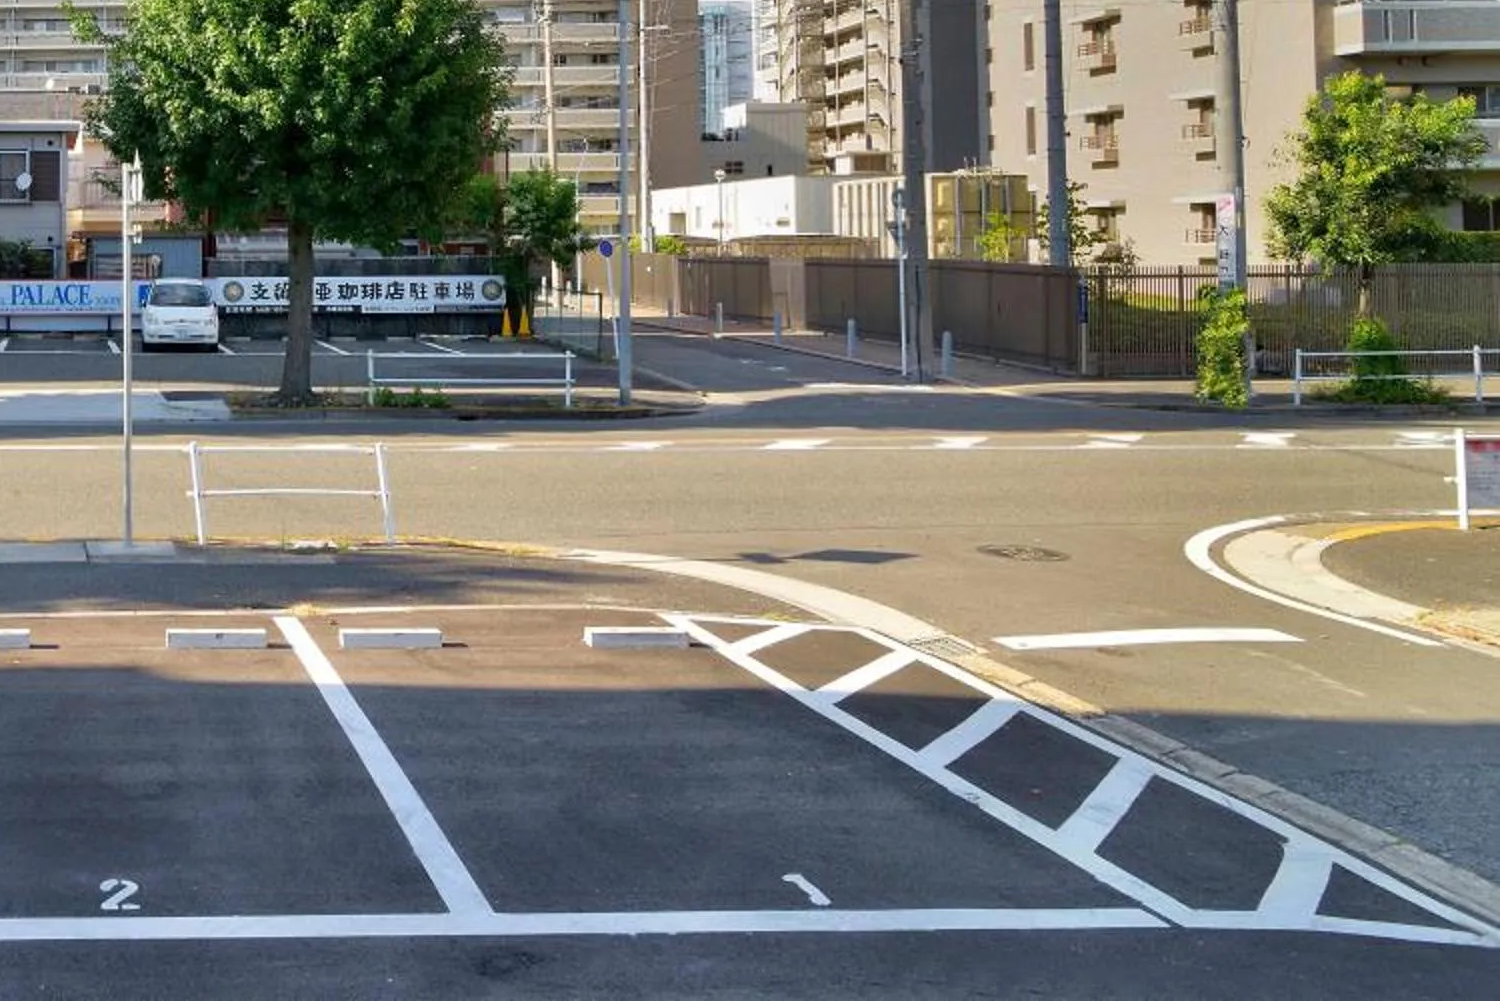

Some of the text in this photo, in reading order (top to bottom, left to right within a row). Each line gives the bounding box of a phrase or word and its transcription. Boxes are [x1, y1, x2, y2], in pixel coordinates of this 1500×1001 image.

[11, 284, 92, 305] PALACE
[99, 878, 141, 910] 2
[782, 873, 832, 906] 1
